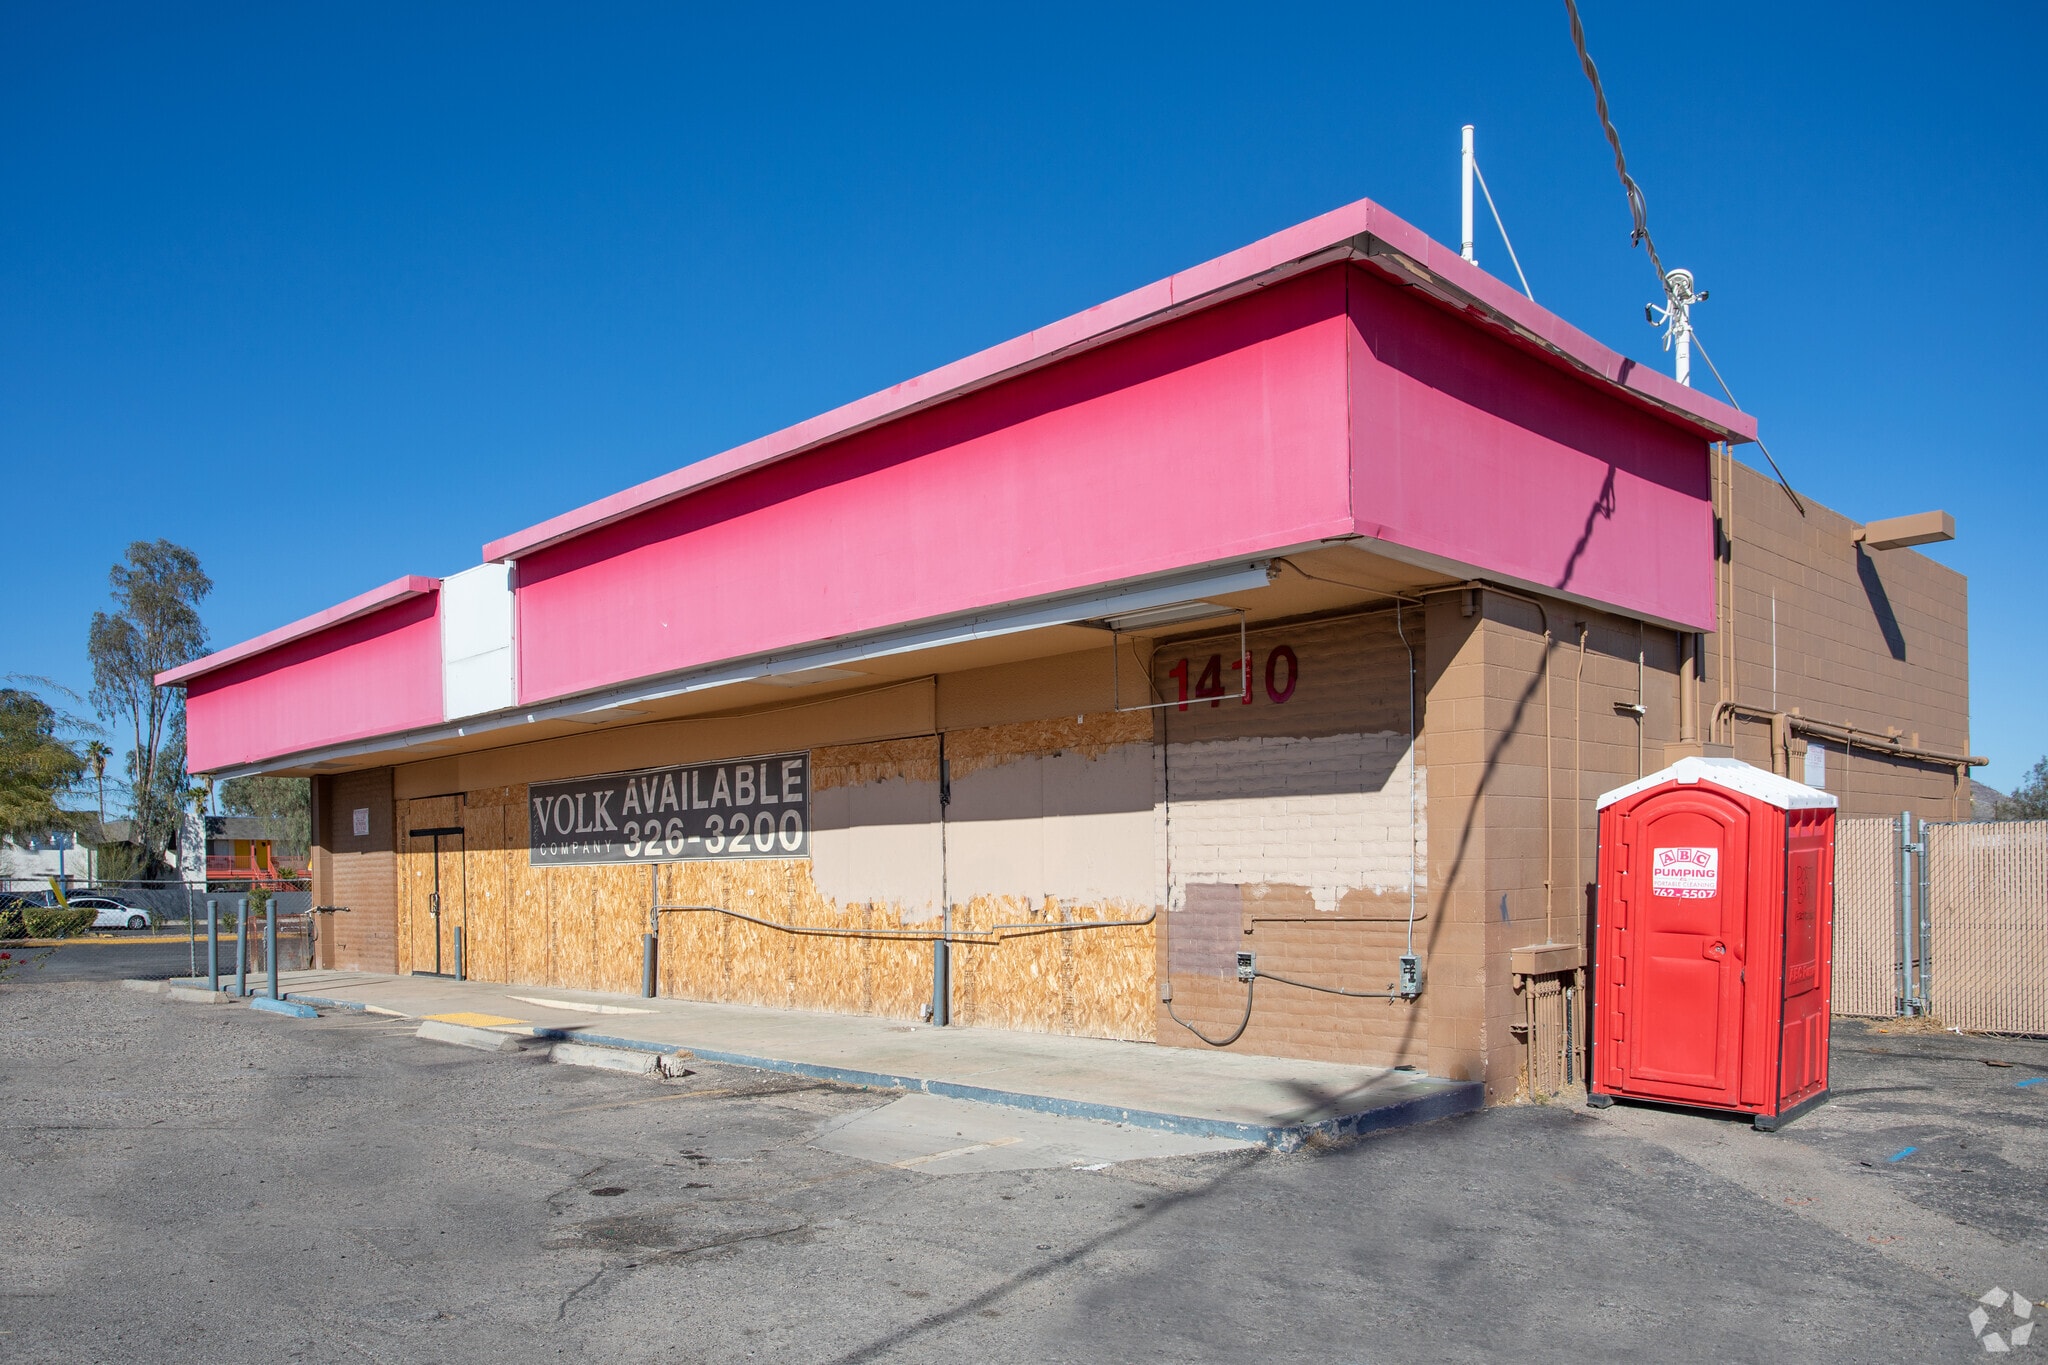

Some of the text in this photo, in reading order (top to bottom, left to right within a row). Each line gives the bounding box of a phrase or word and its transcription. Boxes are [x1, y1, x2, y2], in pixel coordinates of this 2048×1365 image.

[1169, 645, 1298, 711] 1410
[622, 759, 803, 816] AVAILABLE
[532, 790, 618, 836] VOLK
[540, 840, 612, 856] COMPANY
[623, 809, 803, 858] 326-3200
[1654, 868, 1715, 878] PUMPING
[1663, 850, 1707, 865] ABC
[1654, 888, 1715, 899] 762-5507
